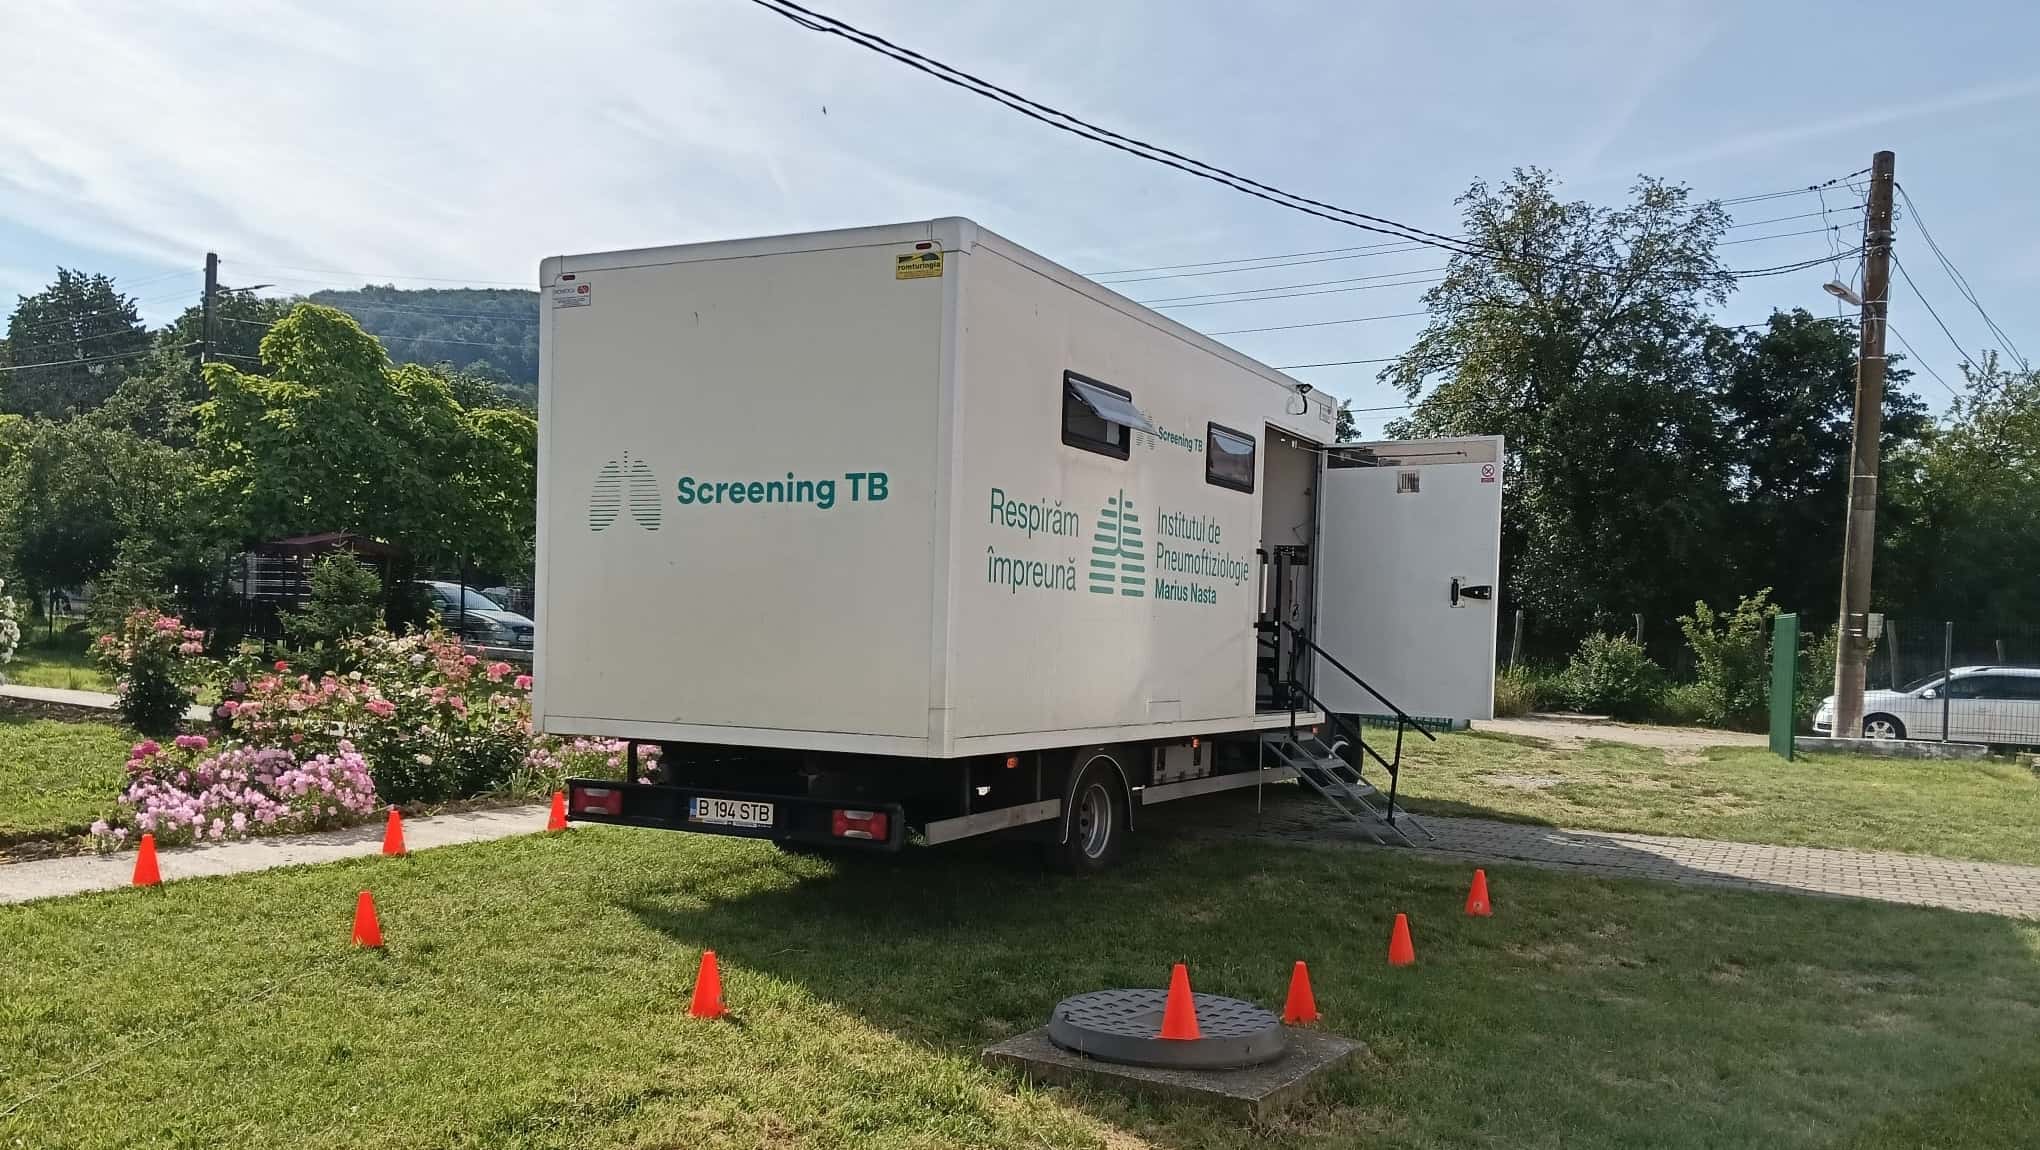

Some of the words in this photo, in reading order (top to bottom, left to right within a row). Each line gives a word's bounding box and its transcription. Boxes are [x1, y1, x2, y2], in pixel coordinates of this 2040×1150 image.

[1158, 426, 1193, 452] Screening
[1194, 438, 1203, 452] TB
[677, 472, 836, 509] Screening
[845, 472, 888, 501] TB
[990, 487, 1080, 539] Respirăm
[1157, 505, 1206, 542] Institutul
[1208, 515, 1221, 544] de
[987, 545, 1077, 594] împreună
[1156, 541, 1249, 586] Pneumoftiziologie
[1154, 577, 1188, 601] Marius
[1190, 582, 1217, 604] Nasta
[699, 799, 710, 817] B
[715, 801, 736, 819] 194
[740, 803, 770, 821] STB
